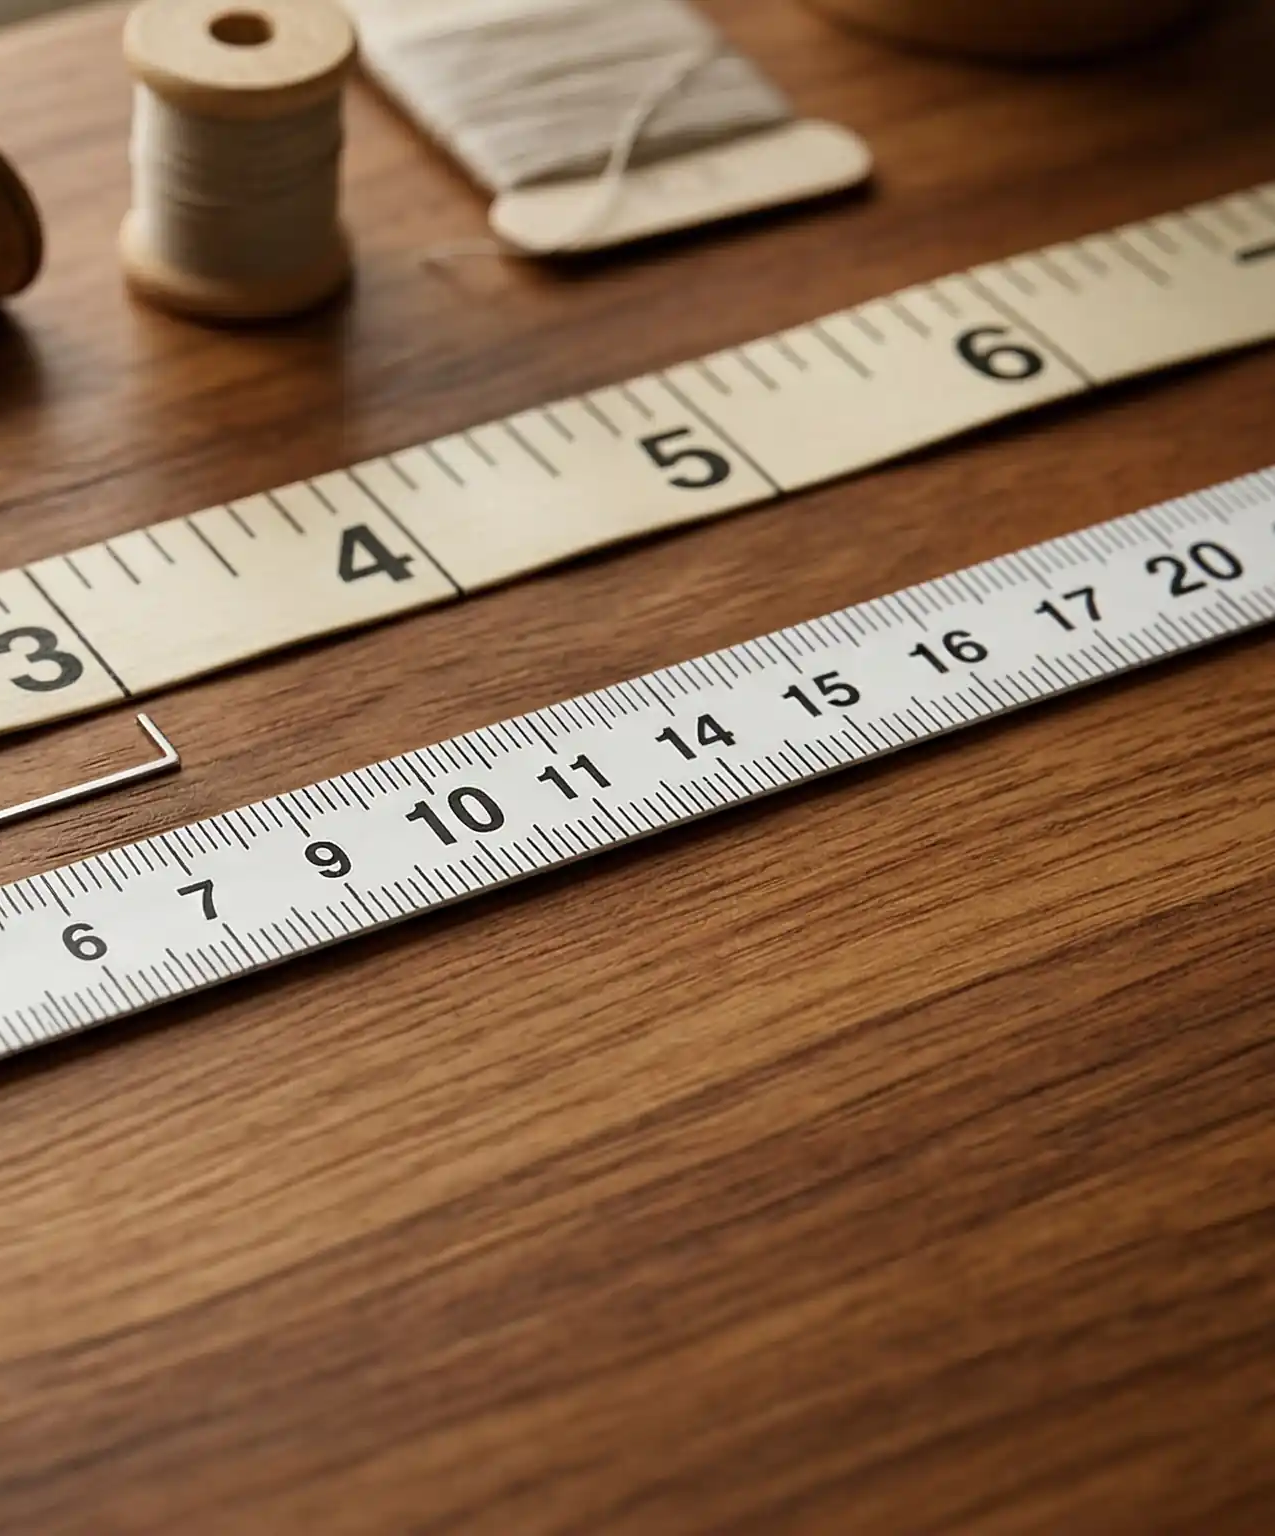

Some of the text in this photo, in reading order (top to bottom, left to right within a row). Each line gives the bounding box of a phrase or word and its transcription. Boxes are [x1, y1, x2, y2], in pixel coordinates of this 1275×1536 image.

[334, 523, 416, 584] 4
[639, 427, 731, 490] 5
[955, 327, 1044, 382] 6
[62, 922, 108, 961] 6
[177, 879, 219, 921] 7
[304, 841, 352, 879] 9
[405, 786, 505, 846] 10
[536, 754, 612, 800] 11
[654, 713, 736, 761] 14
[781, 670, 861, 718] 15
[908, 629, 989, 674] 16
[1034, 586, 1102, 631] 17
[1144, 541, 1244, 597] 20
